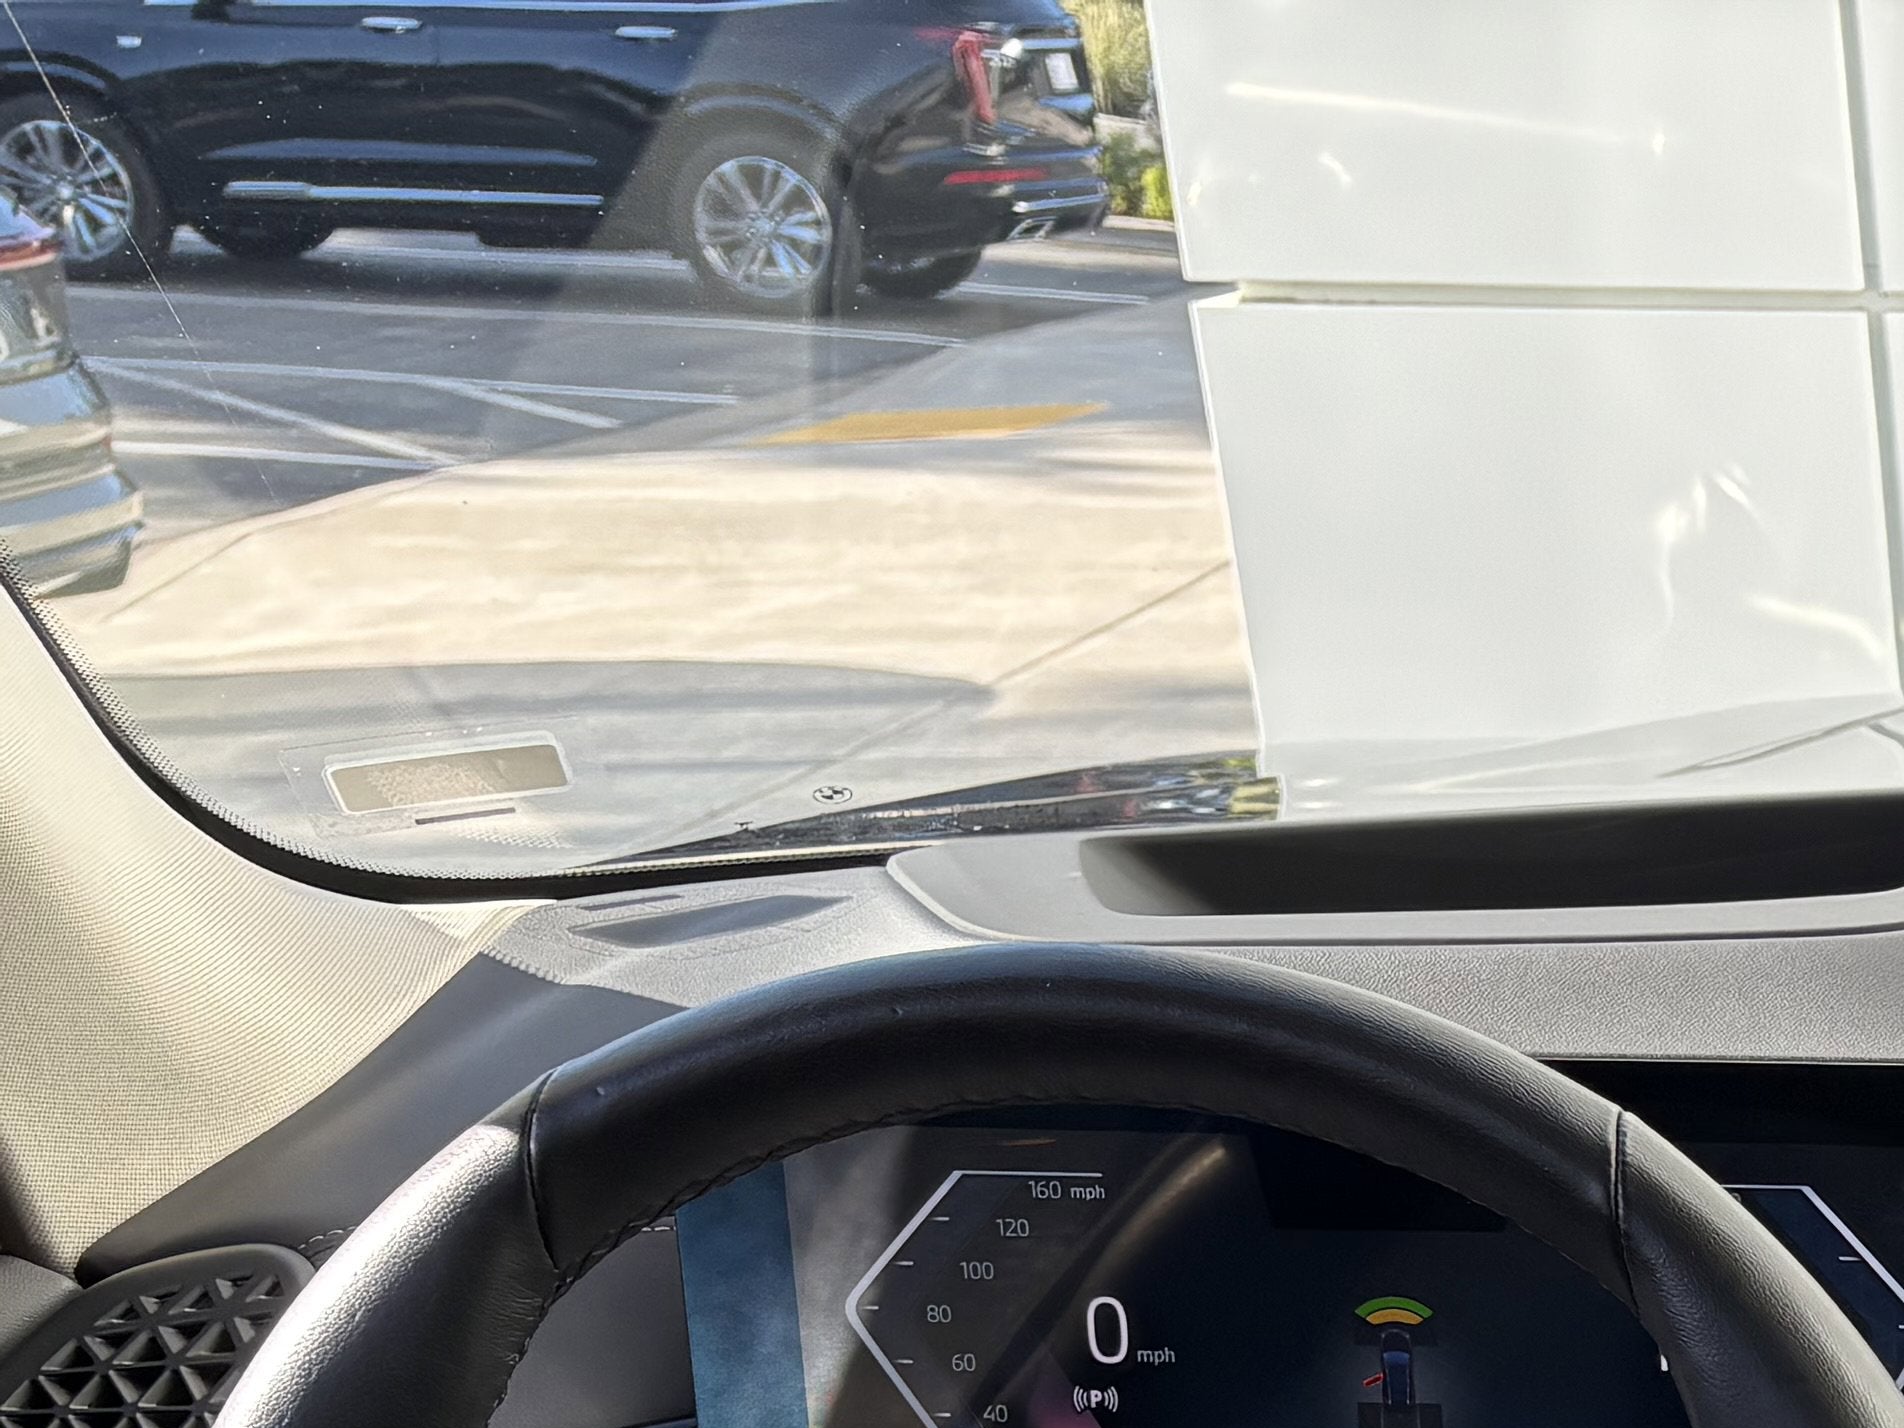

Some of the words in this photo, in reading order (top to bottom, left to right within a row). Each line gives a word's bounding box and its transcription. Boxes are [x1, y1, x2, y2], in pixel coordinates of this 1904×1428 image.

[1029, 1180, 1061, 1199] 160
[1070, 1185, 1105, 1201] mph
[996, 1219, 1030, 1237] 120
[960, 1261, 994, 1280] 100
[927, 1305, 951, 1323] 80
[1086, 1296, 1129, 1365] 0
[952, 1354, 976, 1372] 60
[1137, 1347, 1176, 1367] mph
[983, 1405, 1008, 1423] 40
